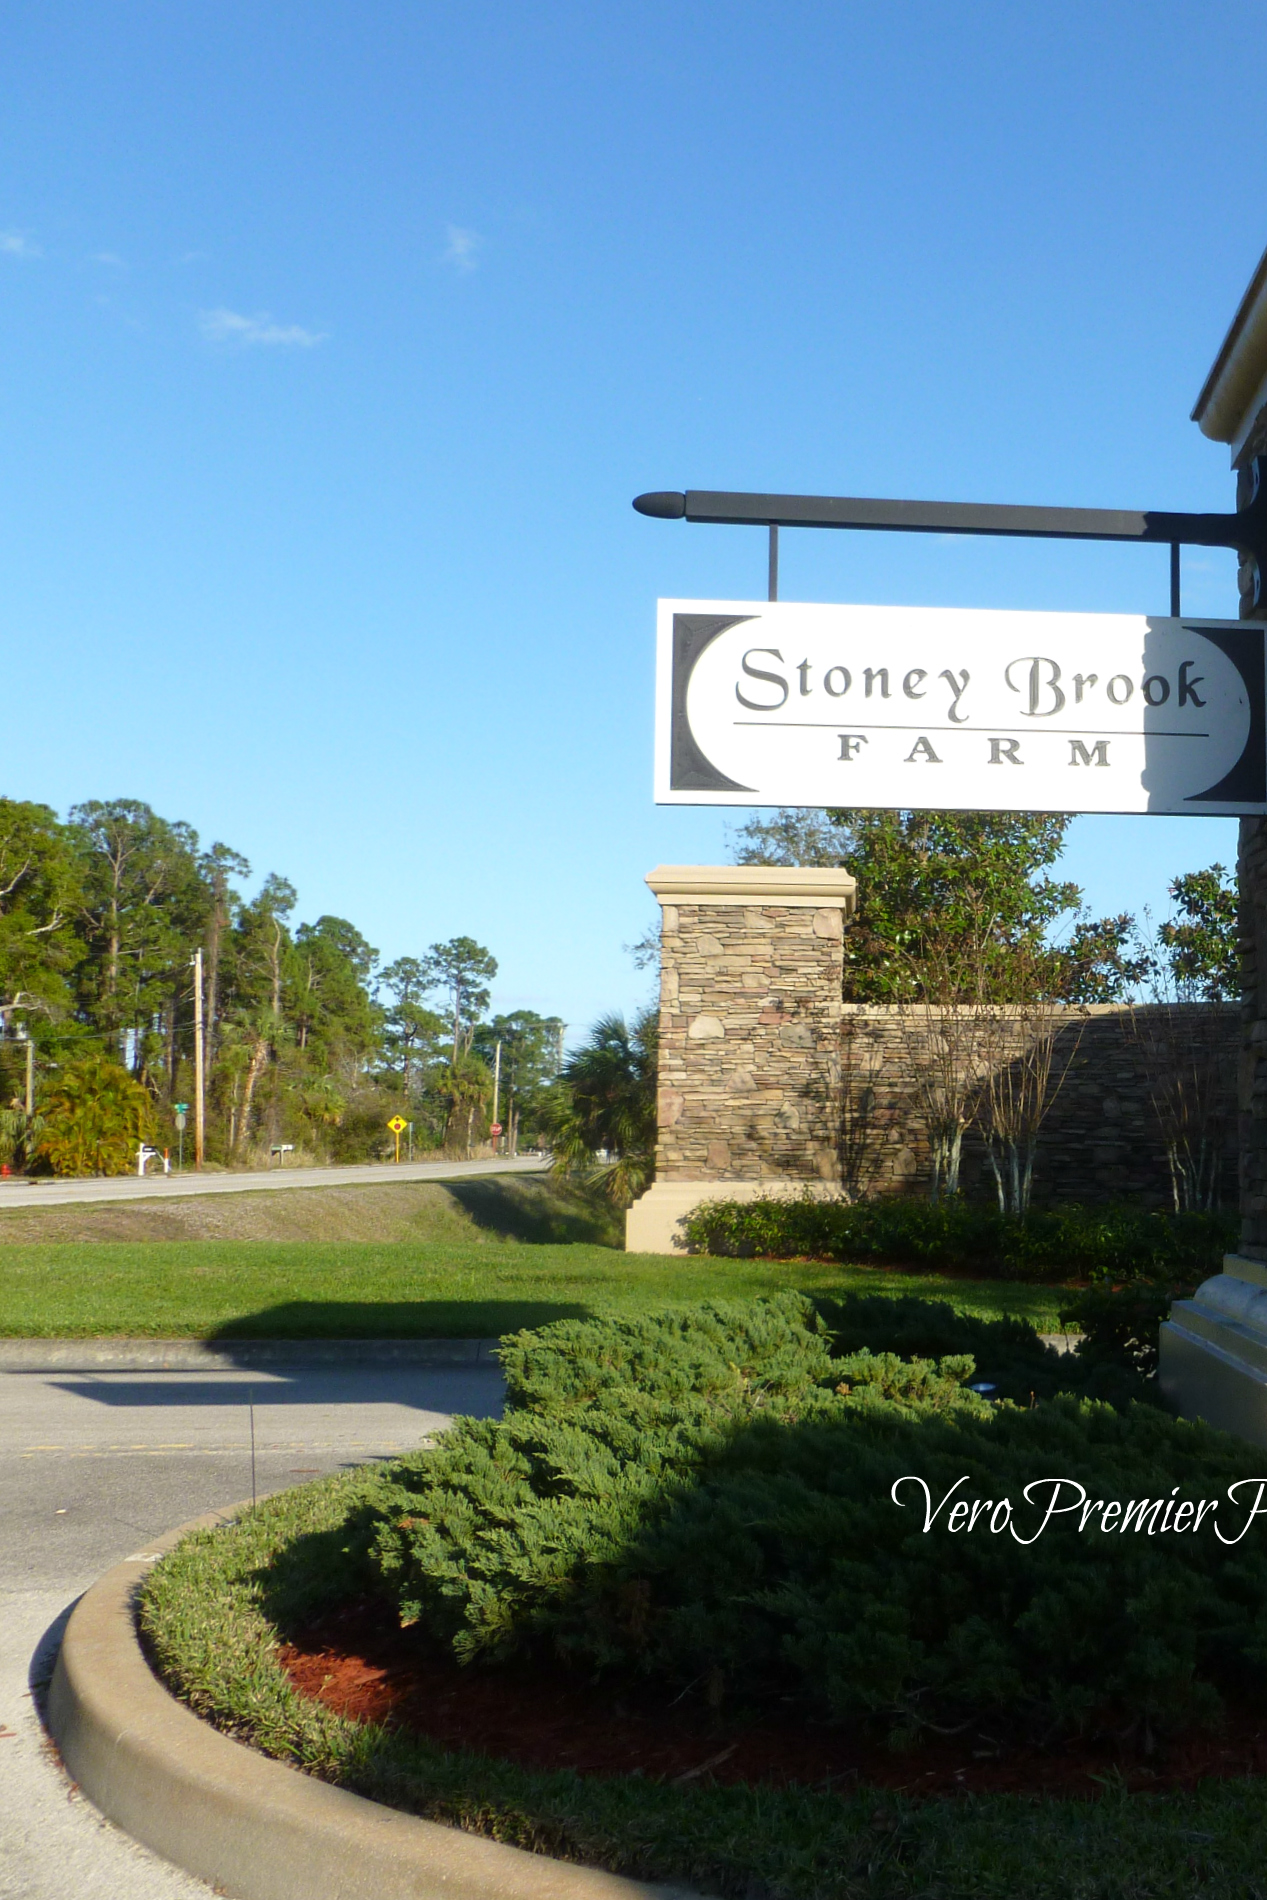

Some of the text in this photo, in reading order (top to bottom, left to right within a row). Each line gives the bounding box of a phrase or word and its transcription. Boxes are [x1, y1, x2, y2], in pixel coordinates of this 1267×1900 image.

[735, 648, 1207, 723] Stoney Brook
[837, 734, 1111, 767] FARM
